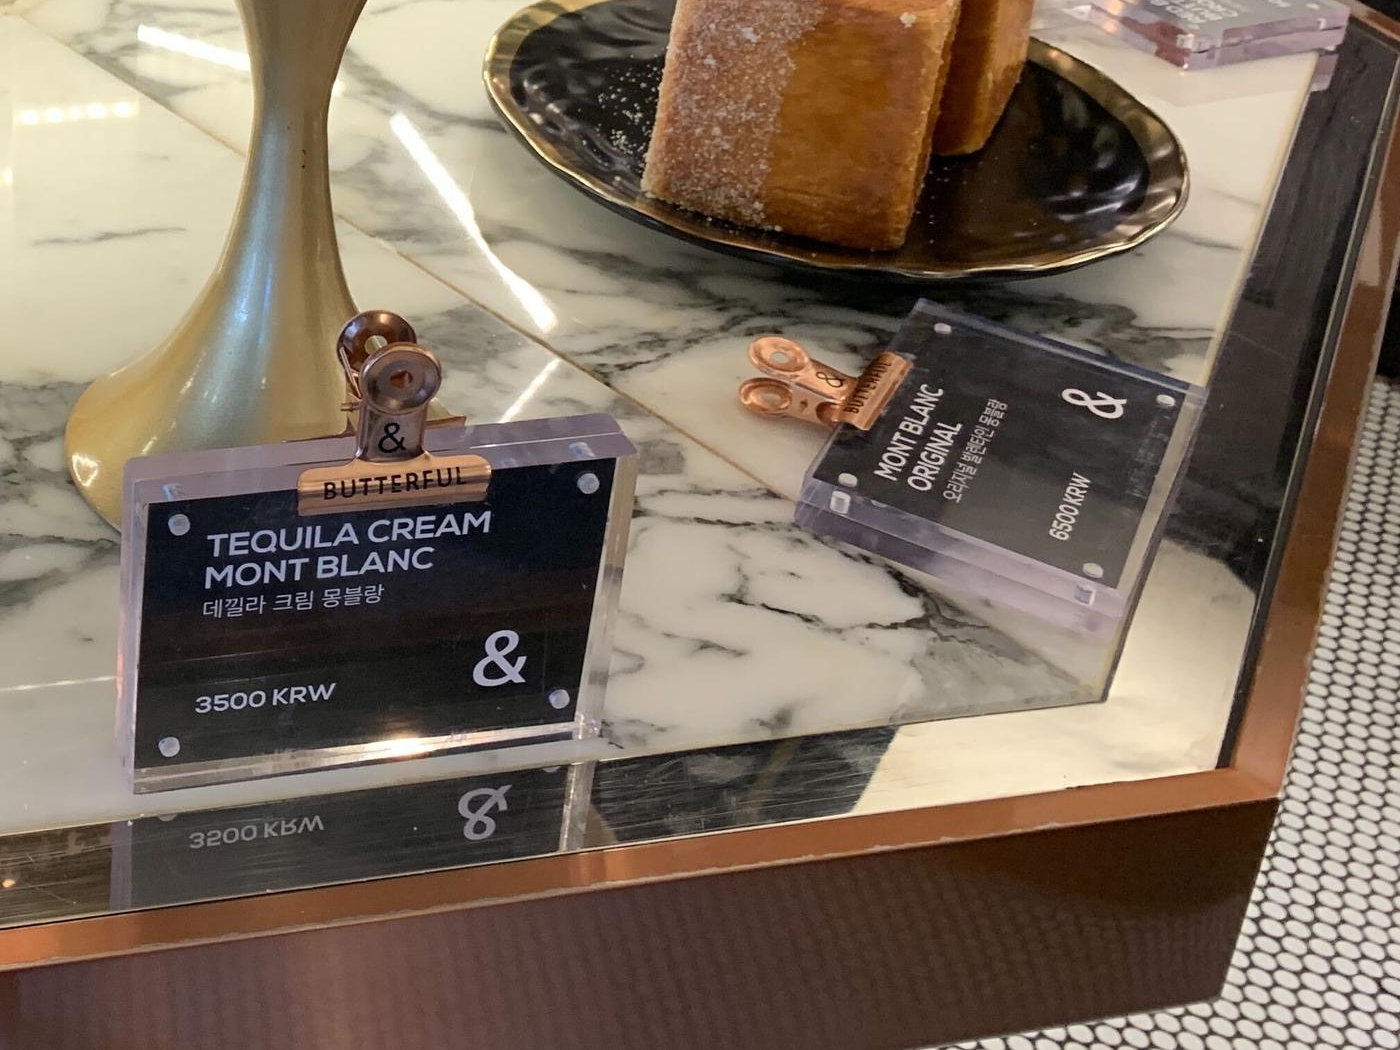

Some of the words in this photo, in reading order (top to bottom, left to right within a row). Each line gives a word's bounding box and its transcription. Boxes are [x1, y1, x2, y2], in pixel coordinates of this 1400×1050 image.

[815, 371, 845, 388] &
[845, 360, 892, 415] BUTTERFUL
[979, 398, 1008, 428] 몽블랑
[1061, 387, 1128, 419] &
[378, 422, 408, 454] &
[874, 430, 917, 482] MONT
[907, 383, 945, 437] BLANC
[959, 423, 995, 466] 발렌타인
[906, 421, 963, 492] ORIGINAL
[322, 466, 468, 501] BUTTERFUL
[942, 460, 980, 503] 오리지널
[1063, 472, 1092, 507] KRW
[207, 523, 362, 558] TEQUILA
[367, 510, 492, 544] CREAM
[1048, 504, 1080, 541] 6500
[204, 557, 310, 590] MONT
[316, 546, 435, 580] BLANC
[202, 595, 267, 619] 데낄라
[273, 589, 314, 613] 크림
[322, 583, 385, 609] 몽블랑
[472, 629, 529, 688] &
[194, 687, 268, 714] 3500
[272, 682, 336, 708] KRW
